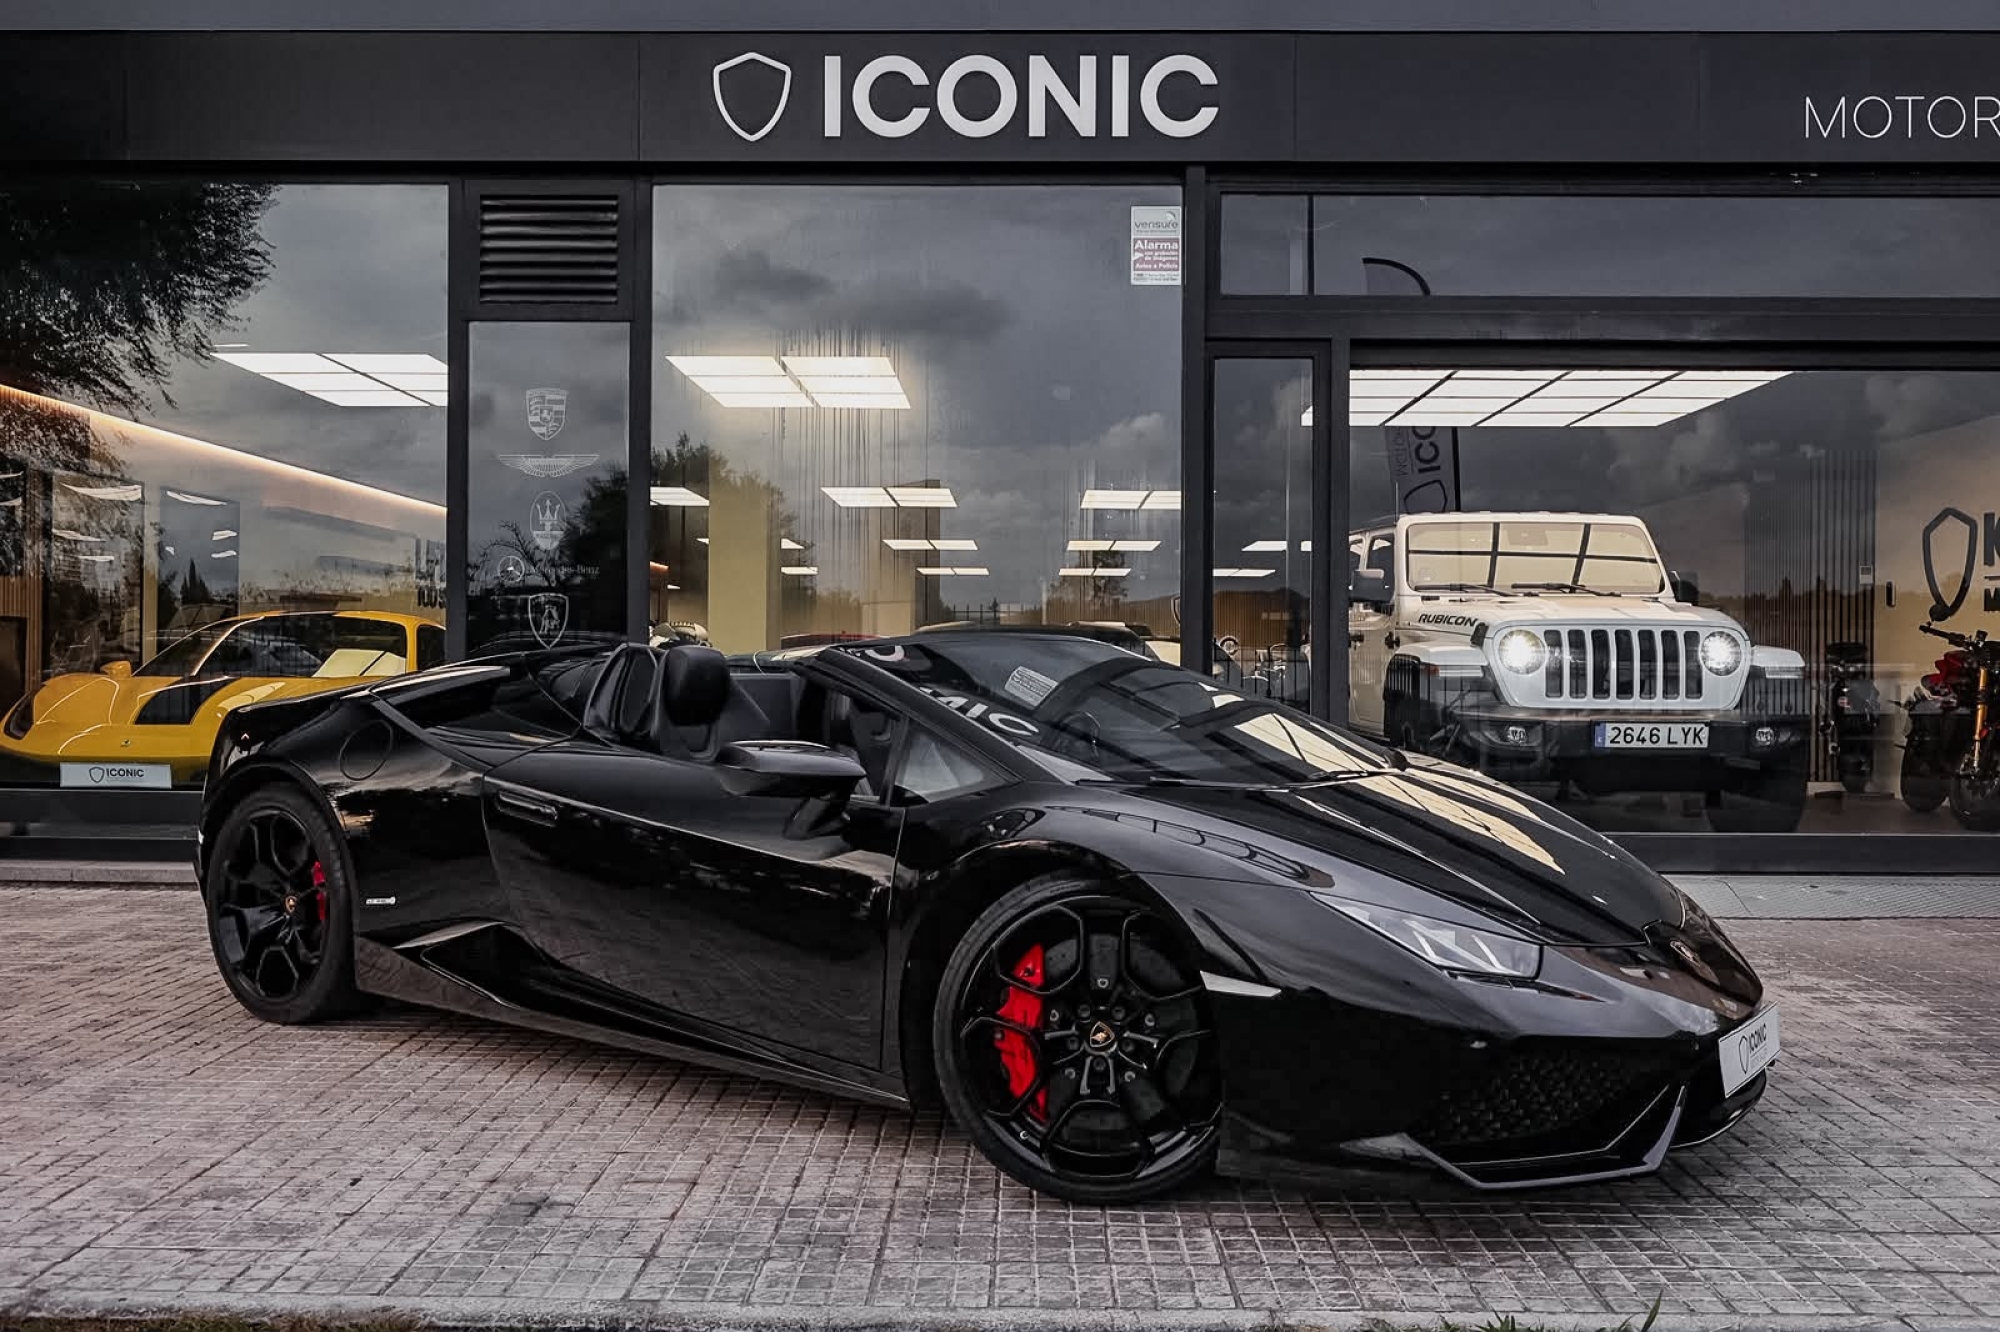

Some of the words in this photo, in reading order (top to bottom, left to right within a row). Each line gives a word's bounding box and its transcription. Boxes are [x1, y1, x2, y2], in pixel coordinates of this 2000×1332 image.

[824, 54, 1219, 138] ICONIC
[1805, 95, 2000, 138] MOTOR
[1134, 239, 1179, 250] Alarma
[1418, 613, 1478, 627] RUBICON
[1610, 726, 1661, 745] 2646
[1667, 726, 1705, 745] LYK
[106, 768, 144, 777] ICONIC
[1748, 1022, 1767, 1054] ICONIC
